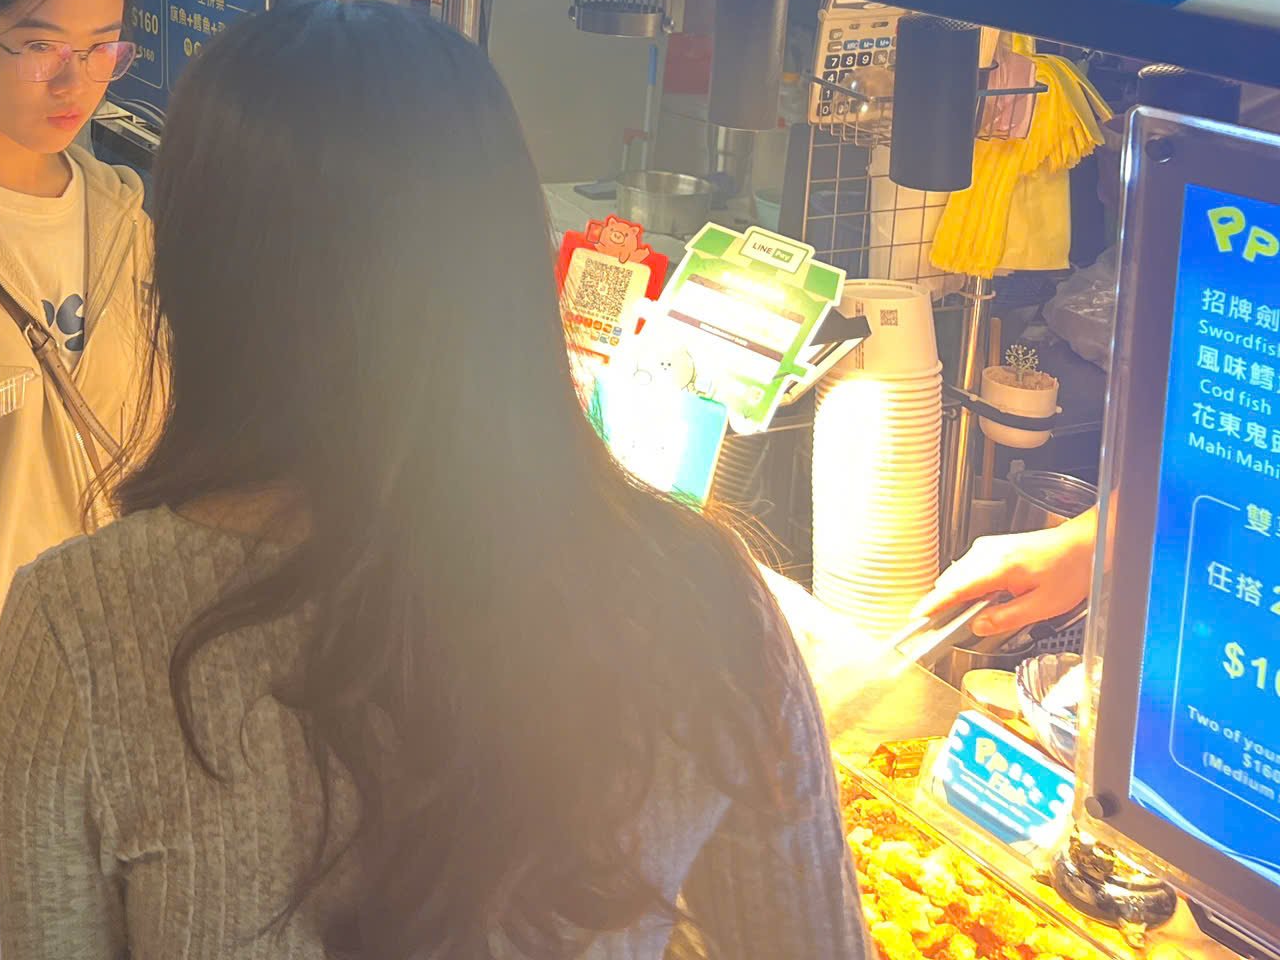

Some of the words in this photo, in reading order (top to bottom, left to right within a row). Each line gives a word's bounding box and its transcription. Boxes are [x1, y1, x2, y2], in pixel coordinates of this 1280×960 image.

[752, 241, 774, 256] LINE
[1207, 206, 1280, 262] PP
[1197, 345, 1280, 395] 風味鱈
[1200, 378, 1235, 402] Cod
[1238, 390, 1272, 416] fish
[1188, 431, 1233, 462] Mahi
[1243, 503, 1280, 538] 雙
[1222, 641, 1280, 696] $1
[1187, 704, 1220, 733] Two
[1223, 727, 1241, 744] of
